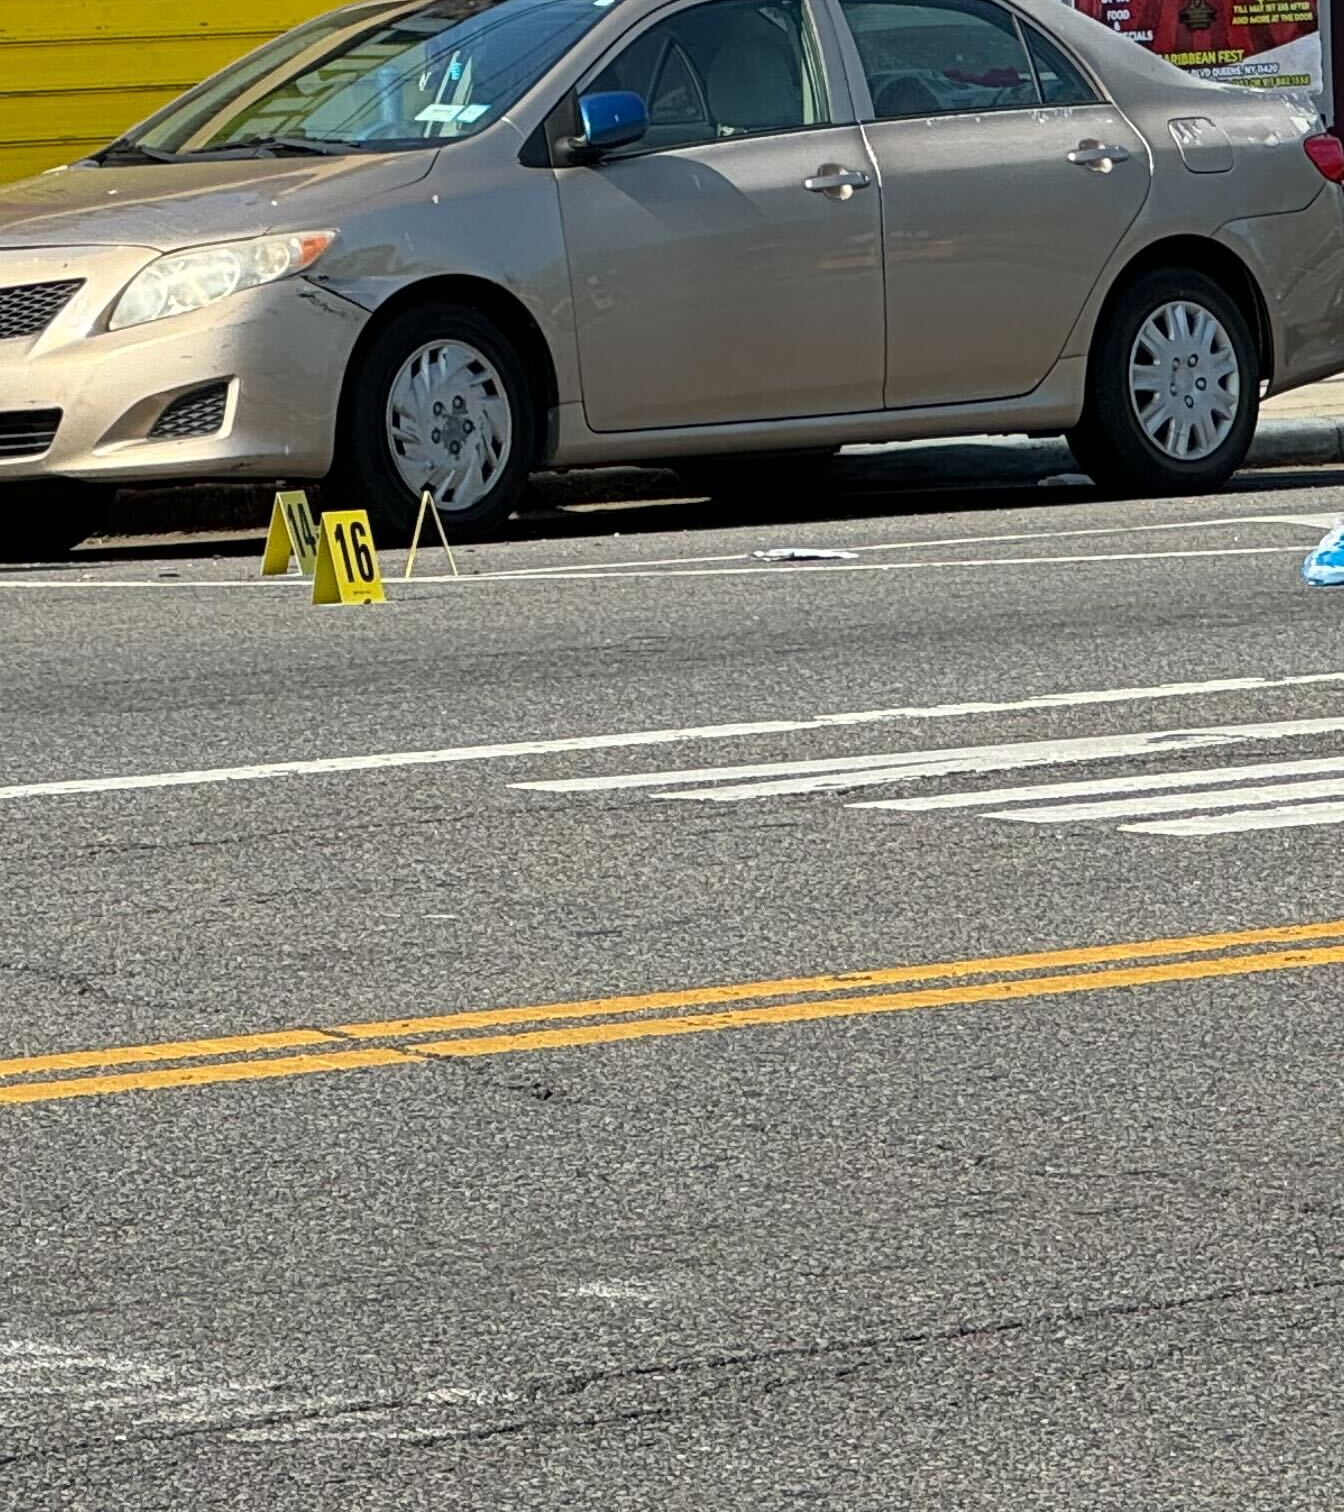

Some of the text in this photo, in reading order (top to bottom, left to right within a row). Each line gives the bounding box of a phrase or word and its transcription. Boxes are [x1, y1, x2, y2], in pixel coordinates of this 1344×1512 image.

[1107, 9, 1130, 21] FOOD
[1218, 49, 1244, 64] FEST
[287, 502, 320, 558] 14
[334, 521, 375, 584] 16
